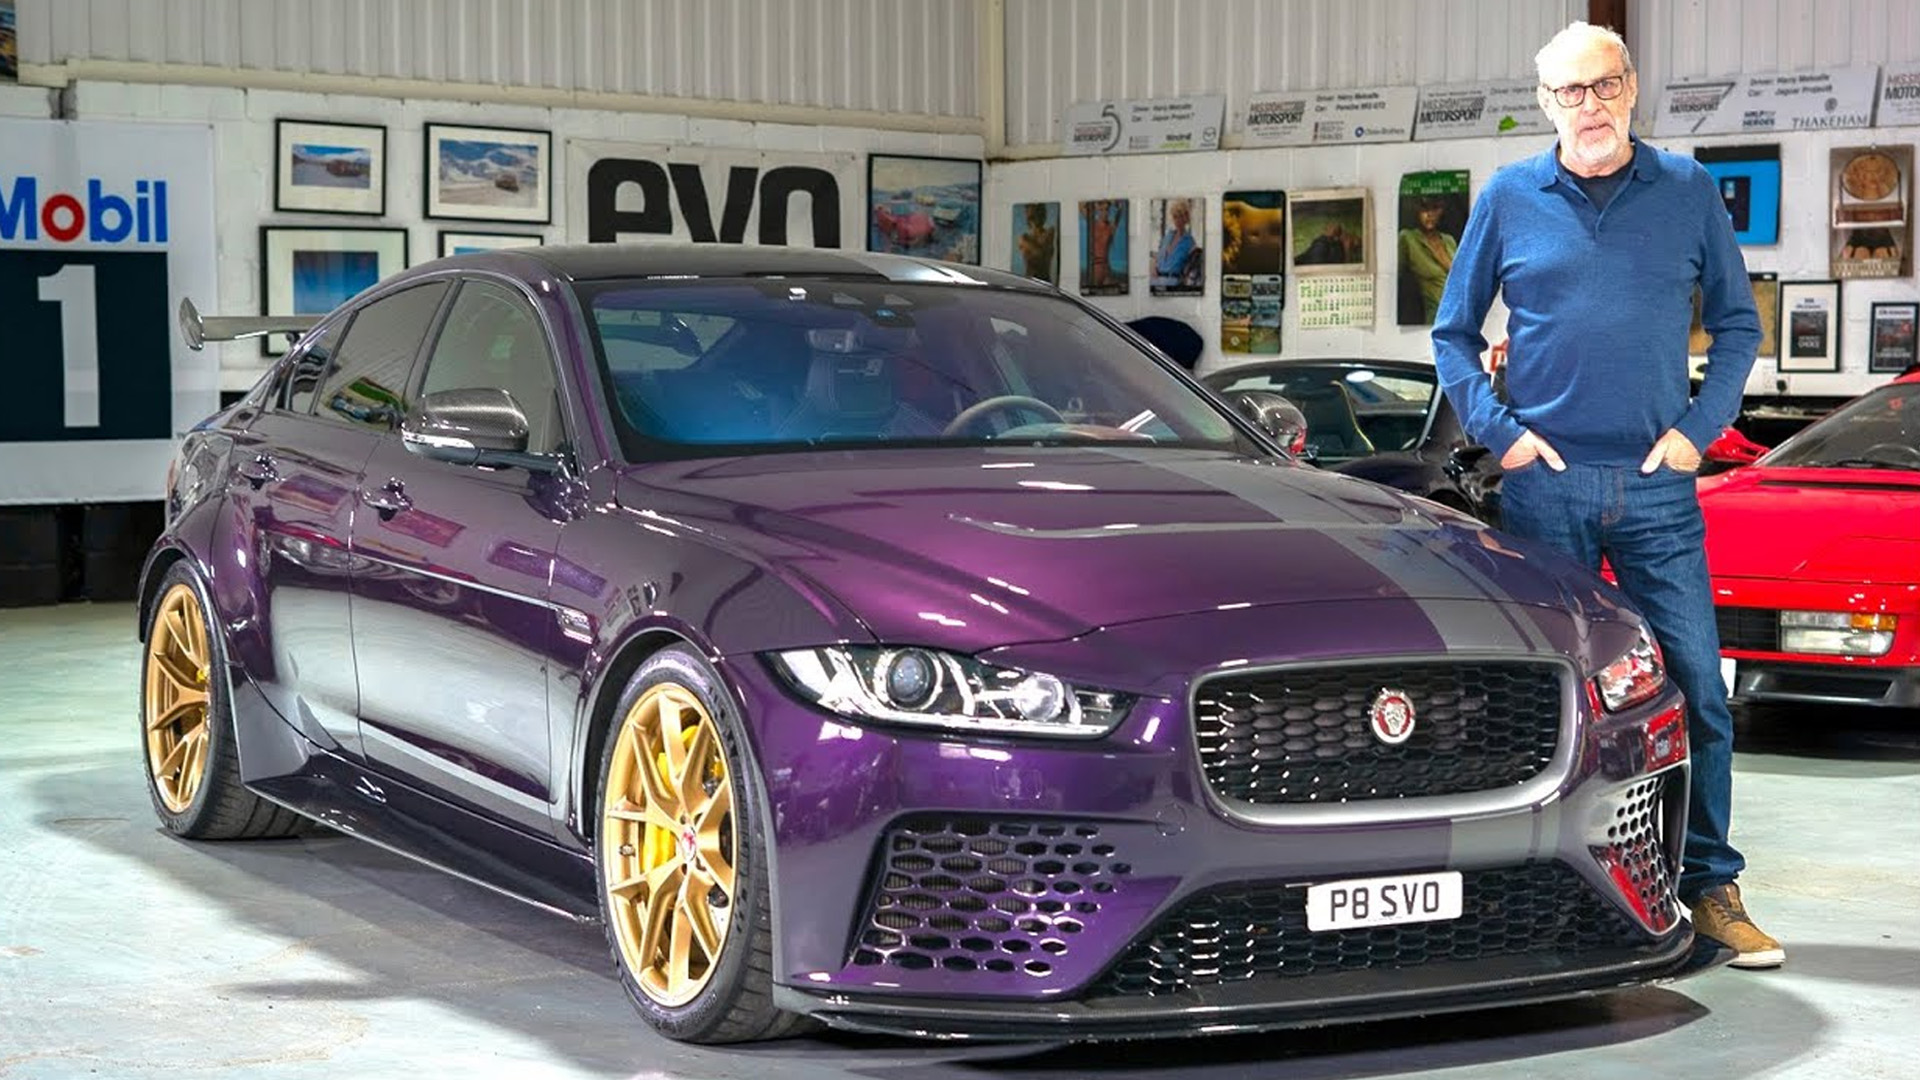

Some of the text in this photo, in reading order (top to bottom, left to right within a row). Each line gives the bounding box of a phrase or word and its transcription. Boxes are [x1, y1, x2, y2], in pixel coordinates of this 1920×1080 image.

[1247, 112, 1303, 126] MOTORSPORT
[1419, 107, 1483, 123] MOTORSPORT
[1792, 114, 1868, 128] THAKEHAM
[0, 177, 168, 243] Mobil
[588, 158, 841, 249] evo
[37, 264, 100, 428] 1
[1331, 881, 1439, 922] P8 SVO
